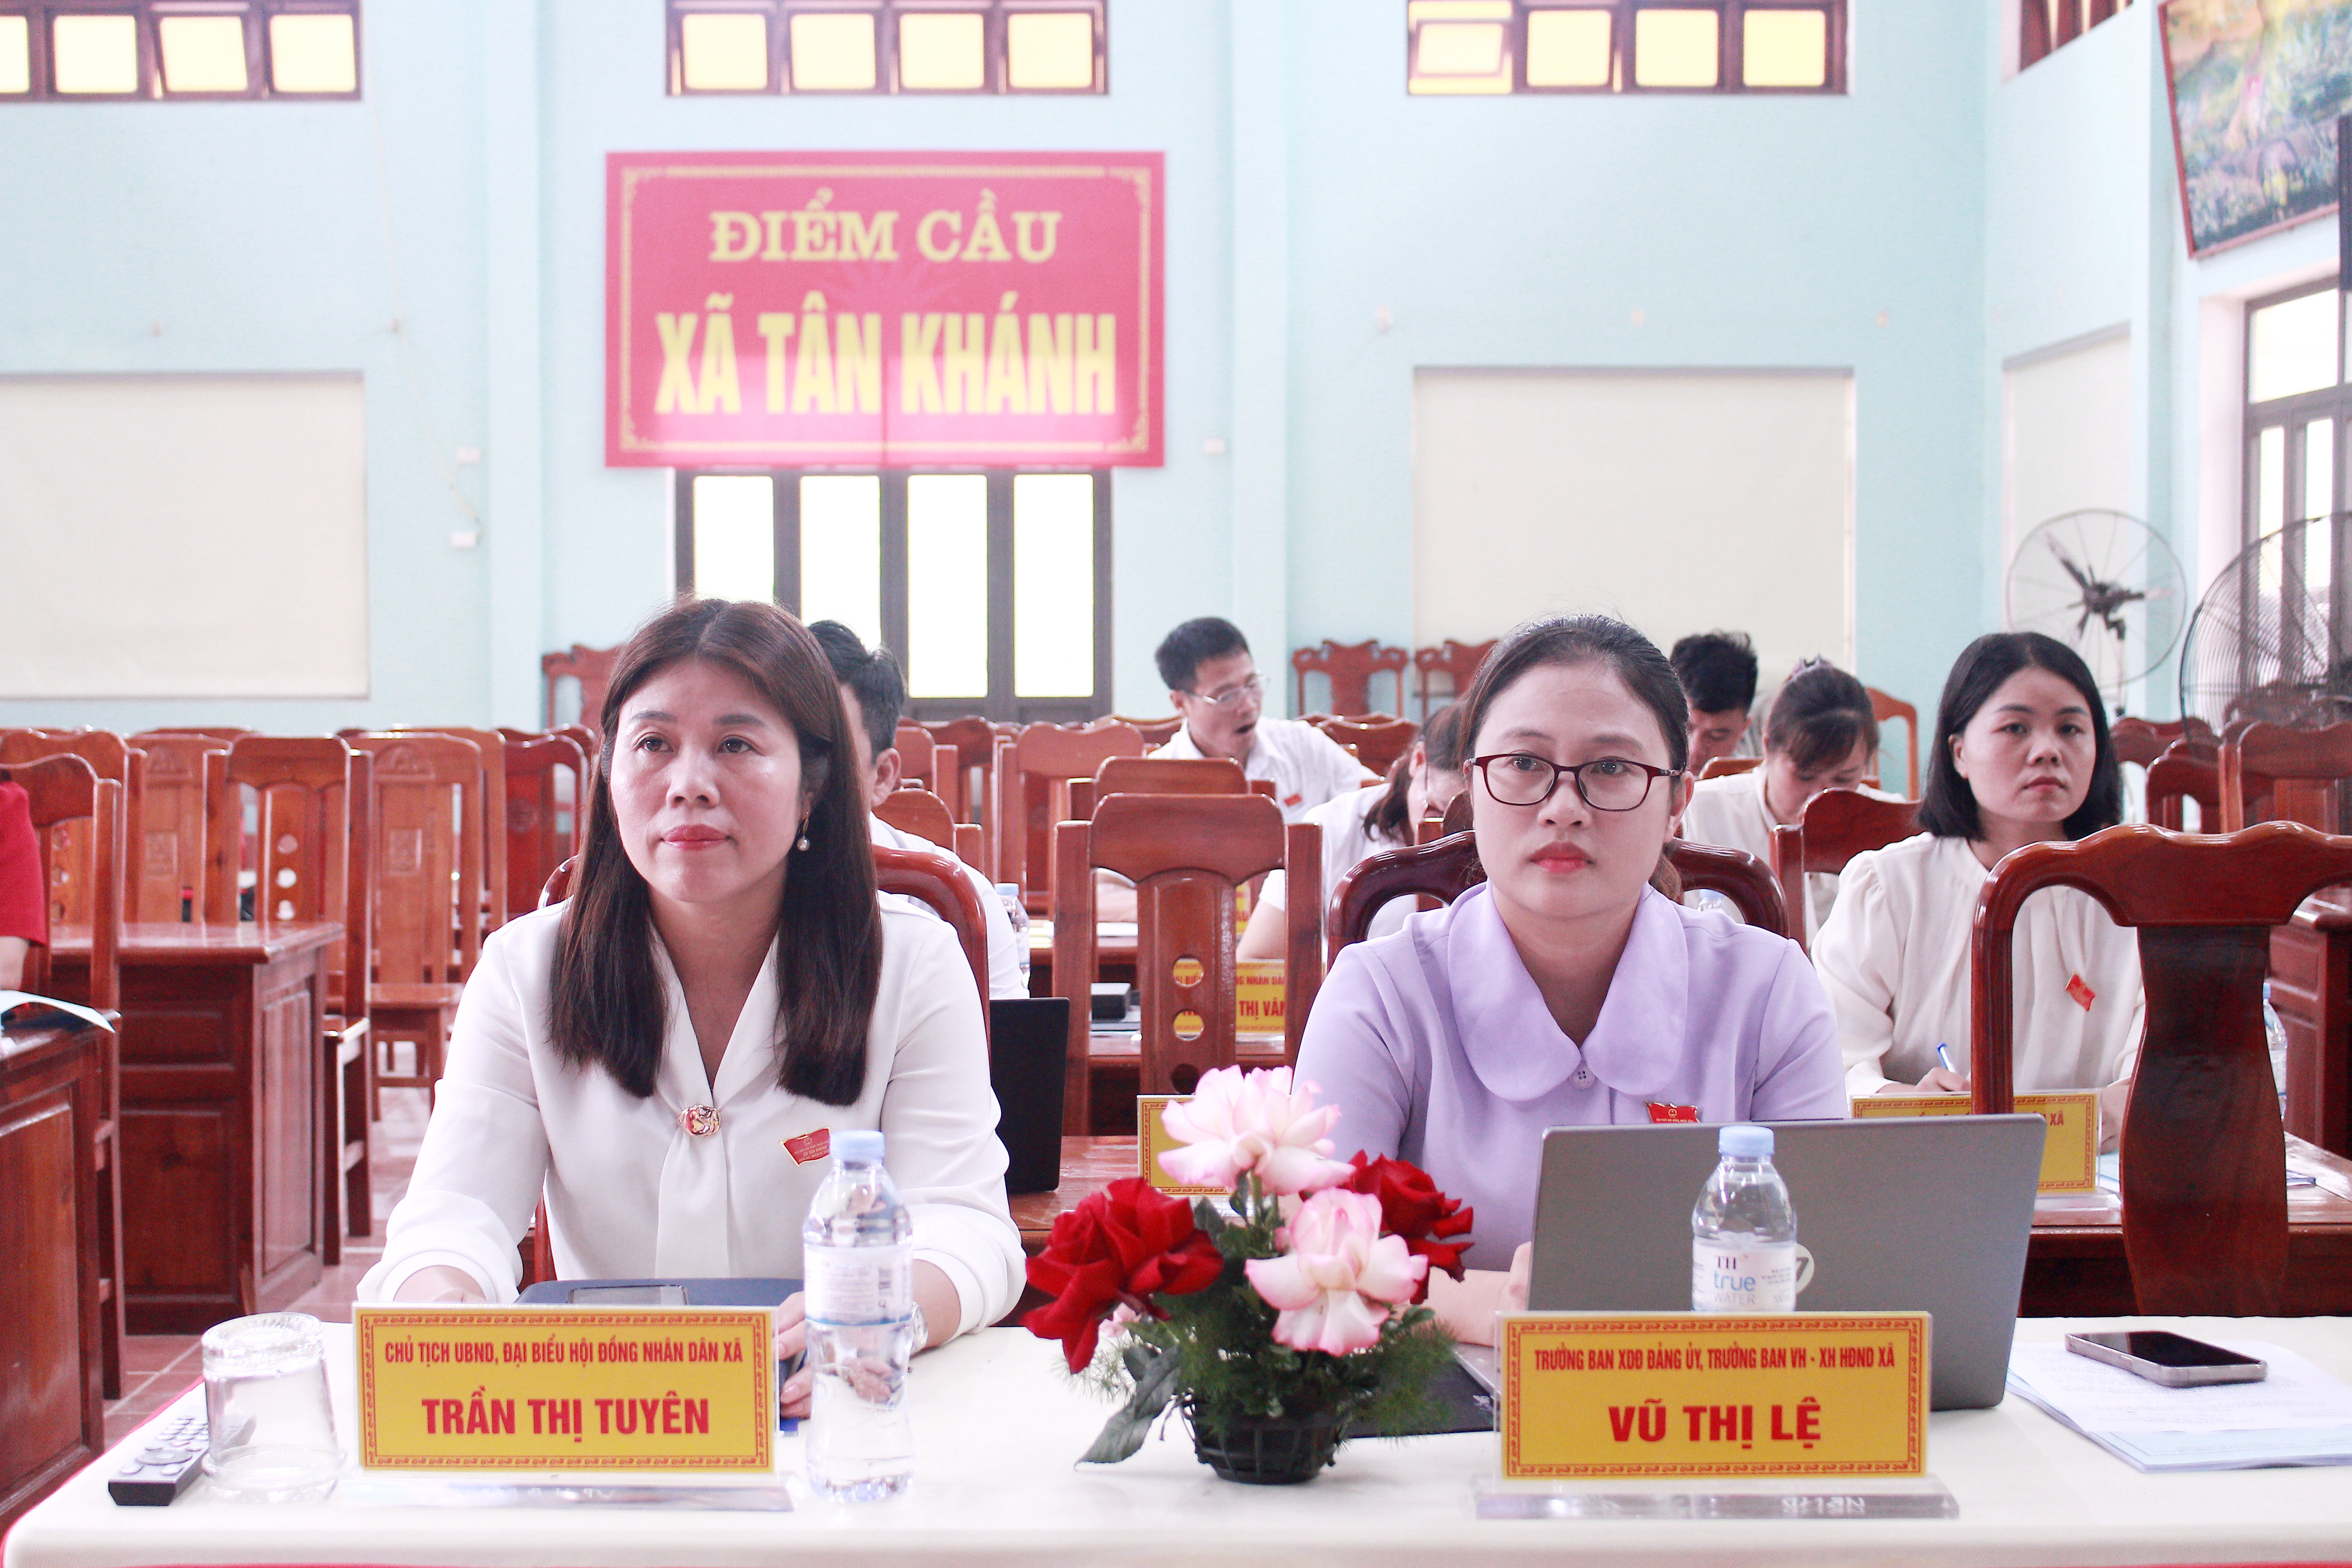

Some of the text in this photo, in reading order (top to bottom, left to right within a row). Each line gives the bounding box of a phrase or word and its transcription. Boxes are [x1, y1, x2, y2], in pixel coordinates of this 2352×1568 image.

[709, 188, 1062, 263] ĐIỂM CẦU
[655, 291, 1116, 415] XÃ TÂN KHÁNH
[1239, 1000, 1259, 1020] THỊ
[1714, 1271, 1756, 1291] true
[386, 1334, 414, 1363] CHỦ
[418, 1342, 450, 1367] TỊCH
[455, 1342, 499, 1365] UBND,
[503, 1342, 527, 1367] ĐẠI
[532, 1333, 565, 1363] BIỂU
[569, 1337, 593, 1367] HỘI
[643, 1337, 684, 1362] NHÂN
[688, 1337, 719, 1362] DÂN
[723, 1337, 743, 1362] XÃ
[1535, 1342, 1584, 1371] TRƯỞNG
[1588, 1349, 1614, 1370] BAN
[1646, 1341, 1682, 1370] ĐẢNG
[1707, 1341, 1757, 1369] TRƯỞNG
[1760, 1348, 1787, 1368] BAN
[1790, 1347, 1807, 1368] VH
[1819, 1347, 1836, 1368] XH
[1878, 1342, 1895, 1367] XÃ
[421, 1385, 709, 1443] TRẦN THỊ TUYÊN
[1608, 1396, 1821, 1450] VŨ THỊ LỆ
